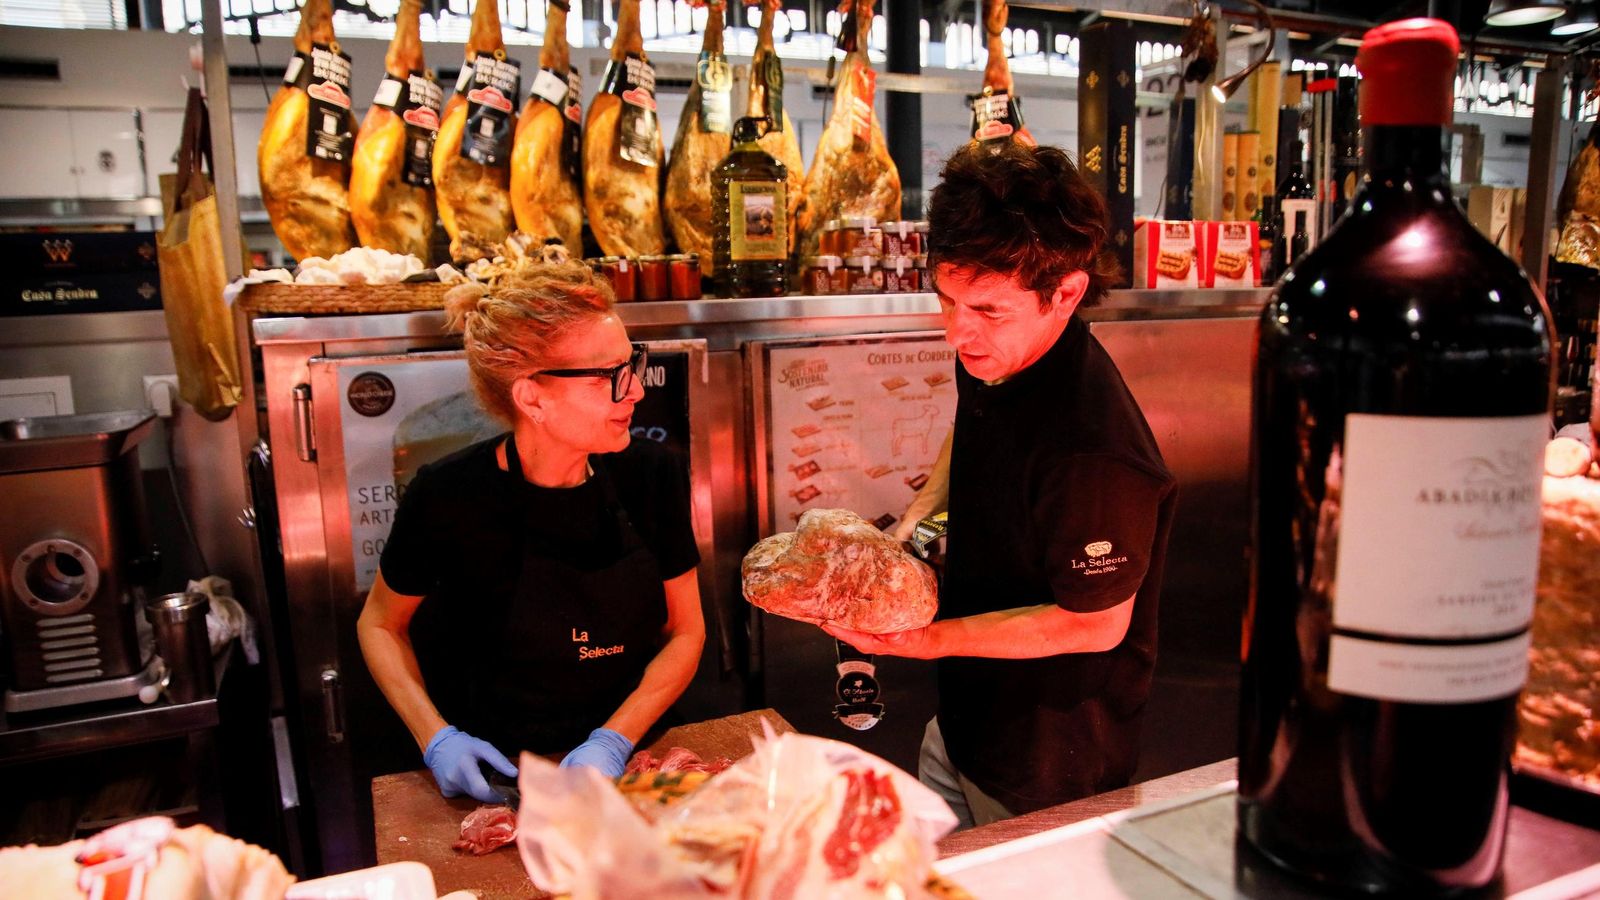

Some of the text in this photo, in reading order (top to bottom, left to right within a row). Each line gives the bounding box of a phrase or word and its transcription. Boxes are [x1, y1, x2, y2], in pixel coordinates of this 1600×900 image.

[1071, 556, 1128, 569] La Selecta
[572, 628, 589, 642] La
[579, 645, 624, 659] Selecta
